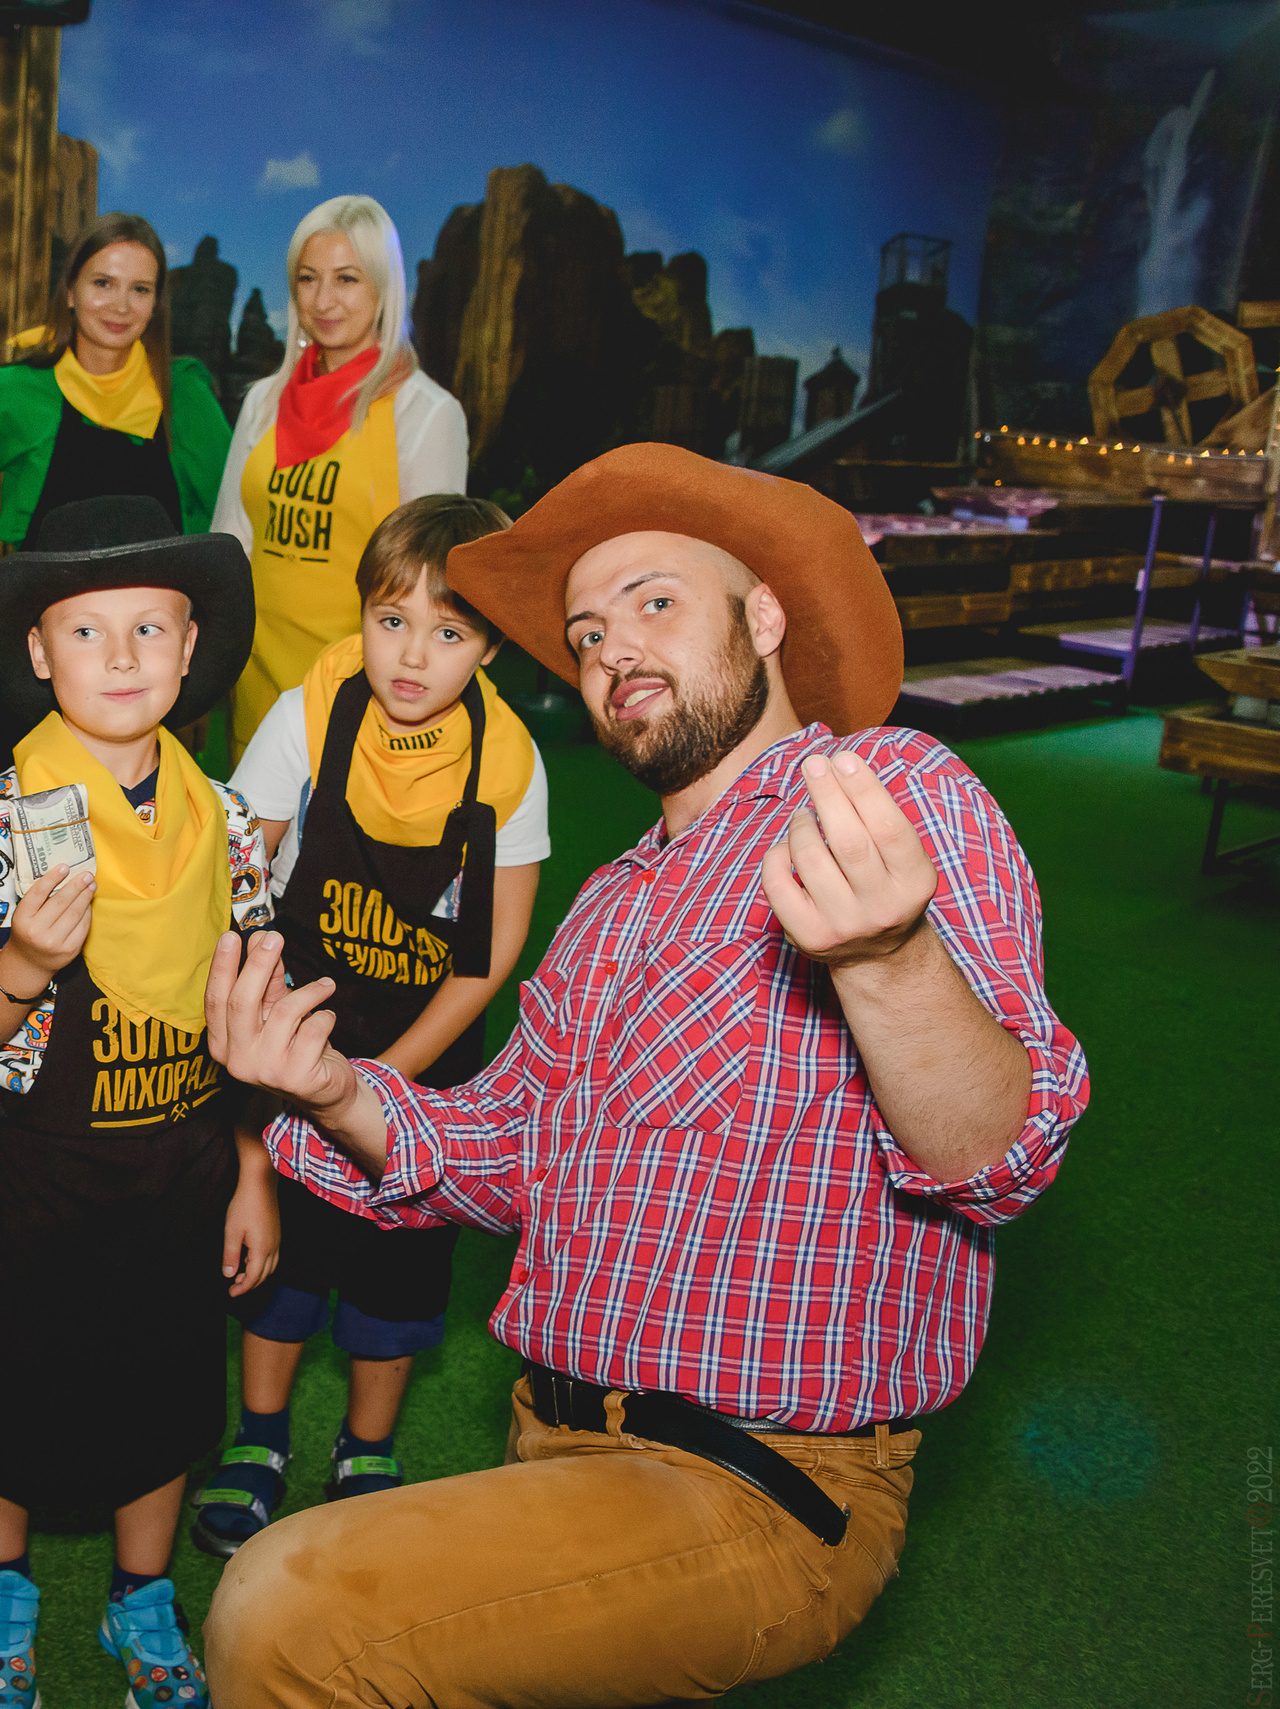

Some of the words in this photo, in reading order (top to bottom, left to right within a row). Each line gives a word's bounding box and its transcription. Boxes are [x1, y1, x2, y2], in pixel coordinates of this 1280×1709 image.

[268, 459, 340, 505] GOLD
[264, 500, 333, 551] RUSH
[36, 846, 50, 872] 100
